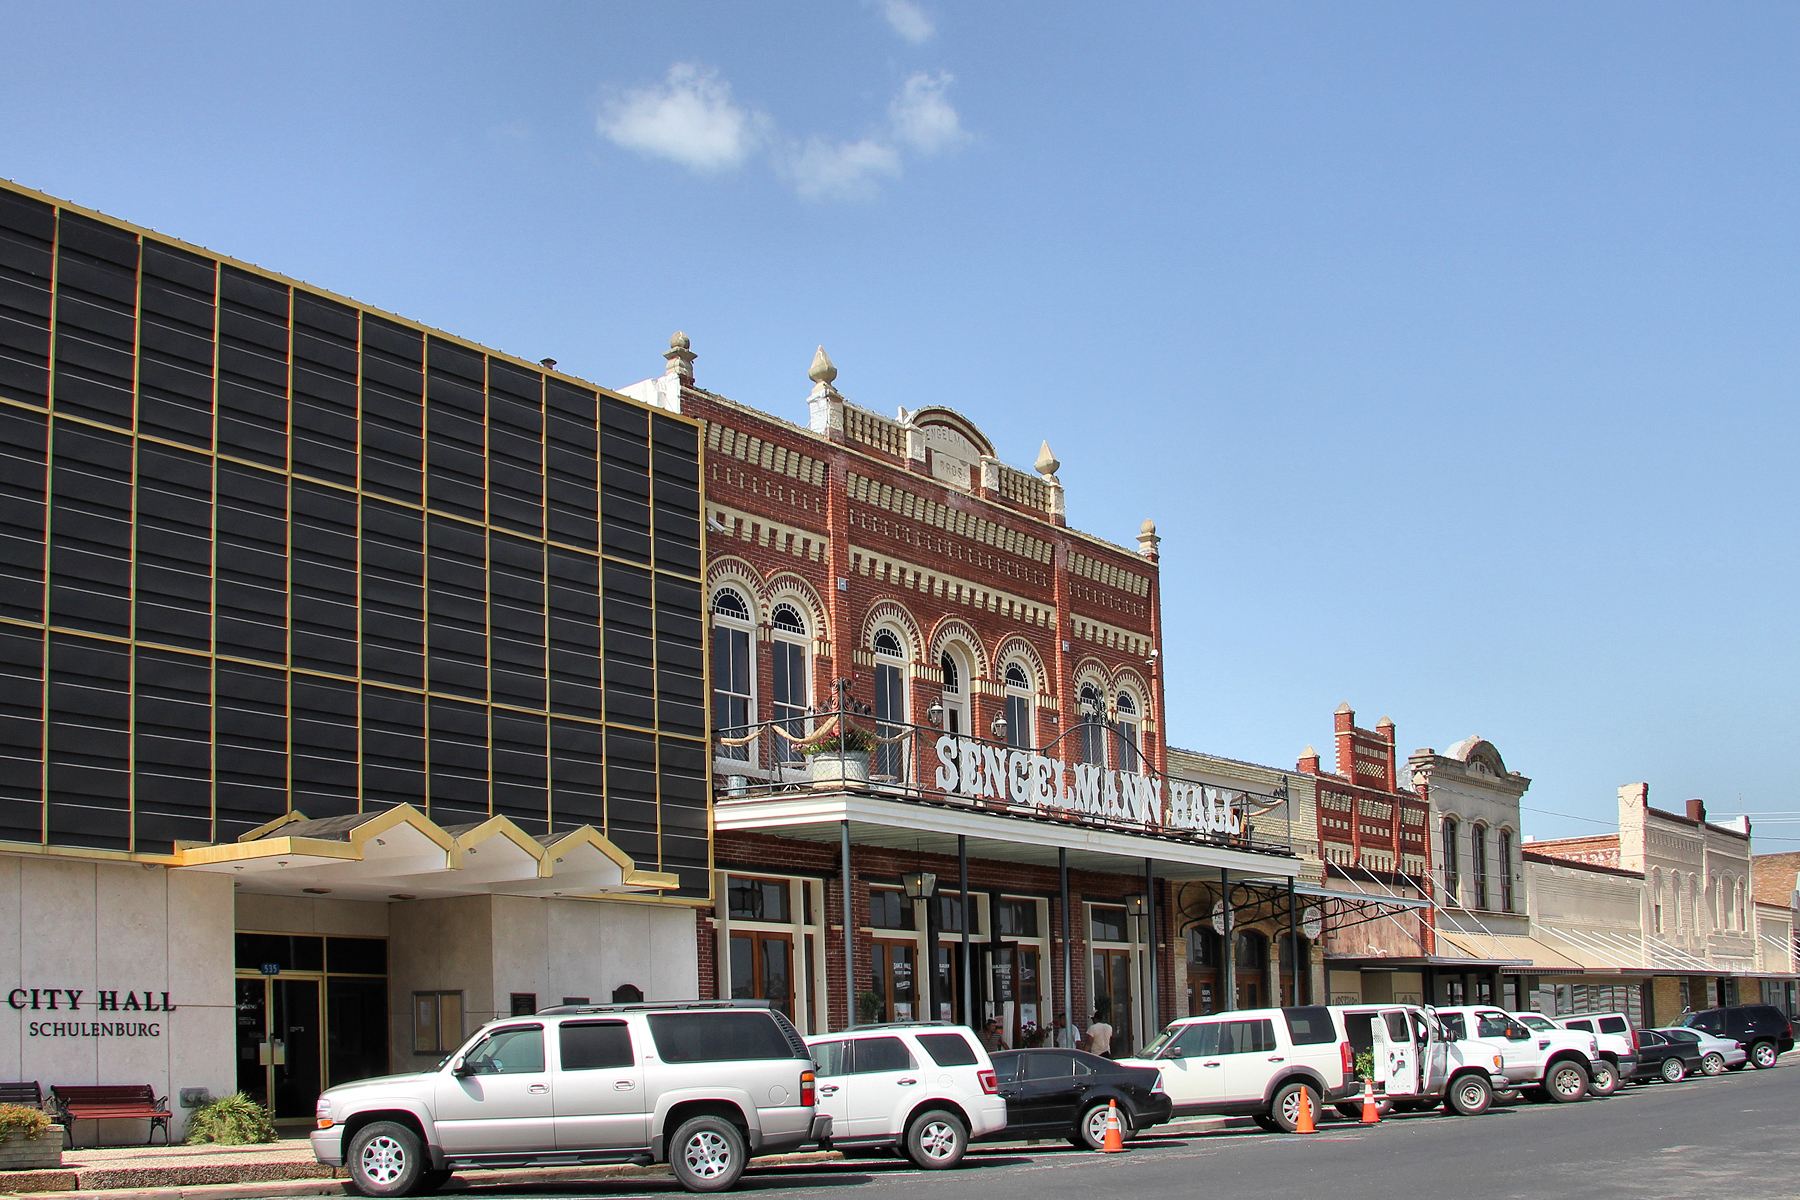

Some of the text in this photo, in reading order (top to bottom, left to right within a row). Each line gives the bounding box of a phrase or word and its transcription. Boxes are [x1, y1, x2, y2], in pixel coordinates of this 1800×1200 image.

[935, 735, 1239, 834] SENGELMANN HALL
[264, 964, 277, 974] 535
[8, 988, 177, 1012] CITY HALL
[29, 1021, 160, 1038] SCHULENBURG
